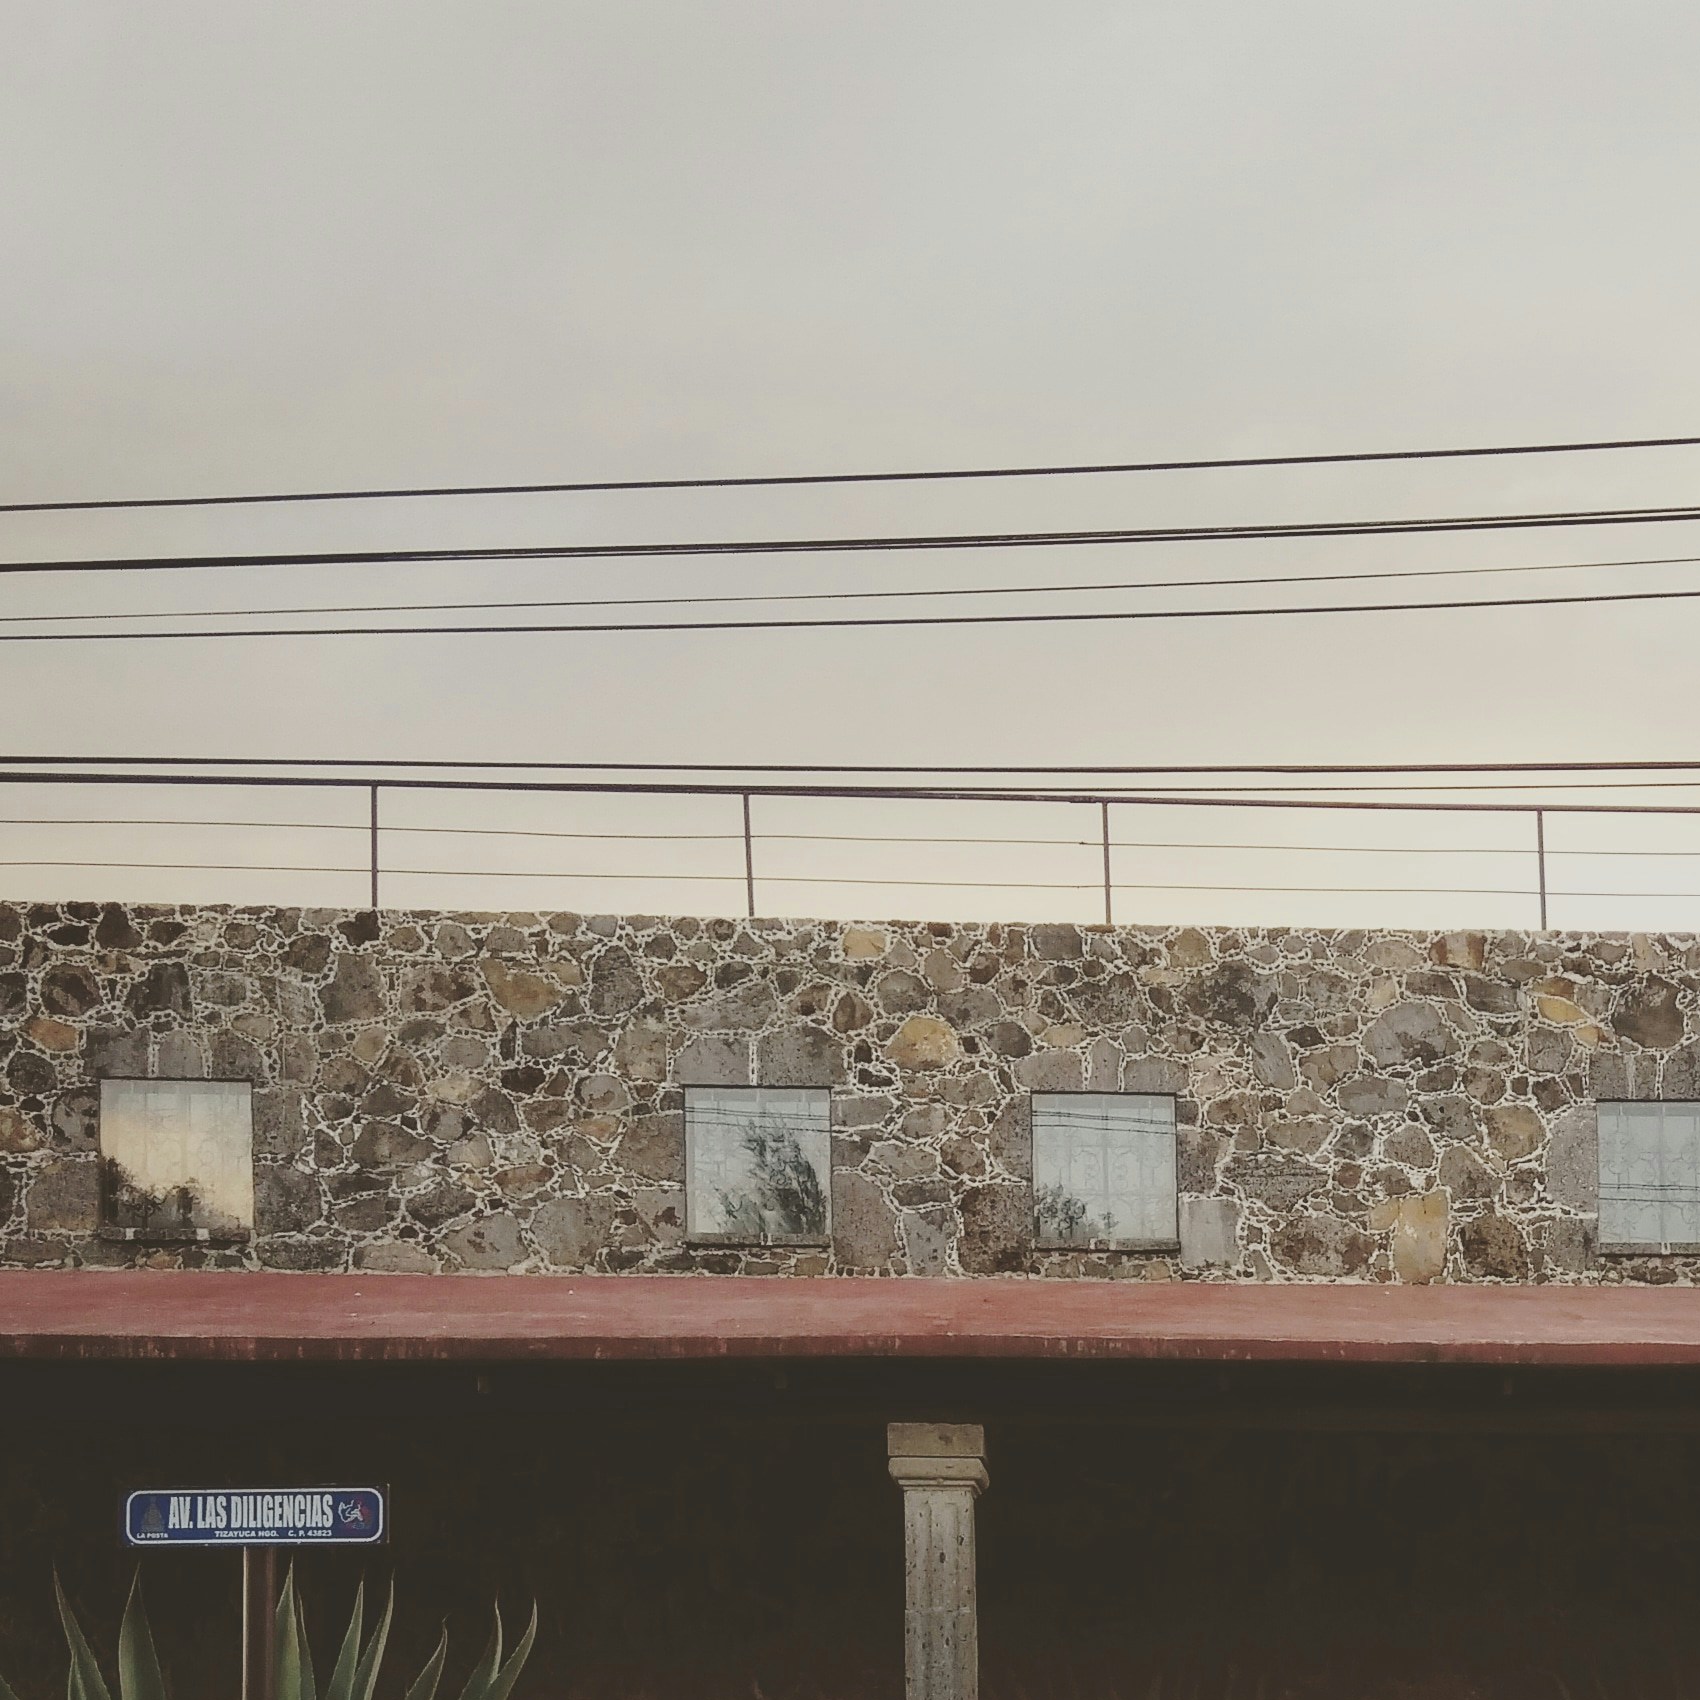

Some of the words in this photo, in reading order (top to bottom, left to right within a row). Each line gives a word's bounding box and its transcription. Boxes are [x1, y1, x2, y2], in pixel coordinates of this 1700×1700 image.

[168, 1496, 194, 1530] AV.
[196, 1495, 227, 1529] LAS
[230, 1494, 334, 1529] DILIGENCIAS
[214, 1530, 256, 1538] TIZAYUCA
